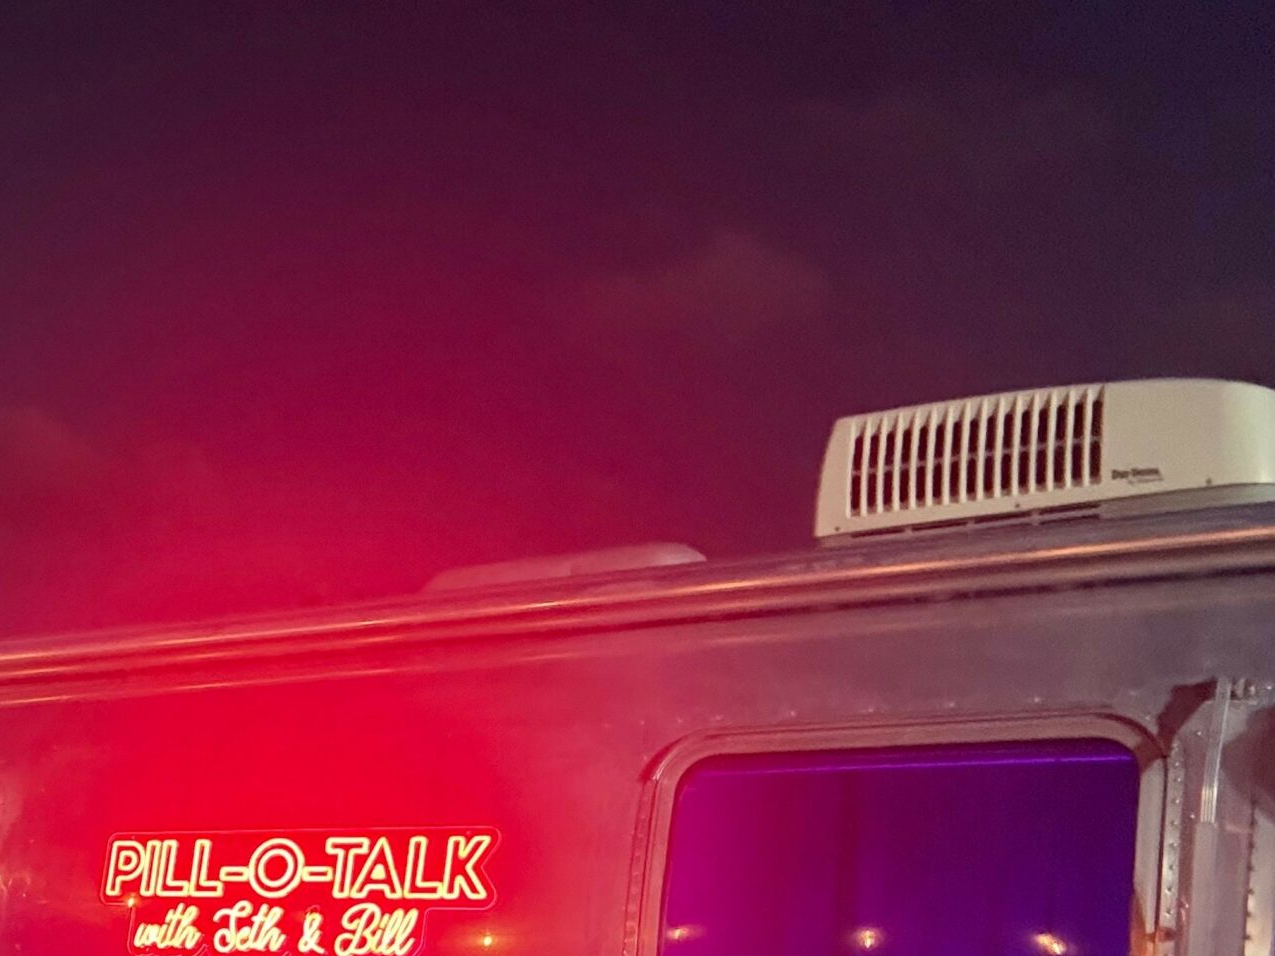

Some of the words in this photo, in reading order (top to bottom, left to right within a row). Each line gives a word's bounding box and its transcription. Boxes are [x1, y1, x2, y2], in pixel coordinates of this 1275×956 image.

[105, 835, 491, 899] PILL-O-TALK
[133, 903, 200, 950] with
[212, 901, 286, 953] Seth
[297, 909, 325, 955] &
[333, 902, 419, 956] Bill
